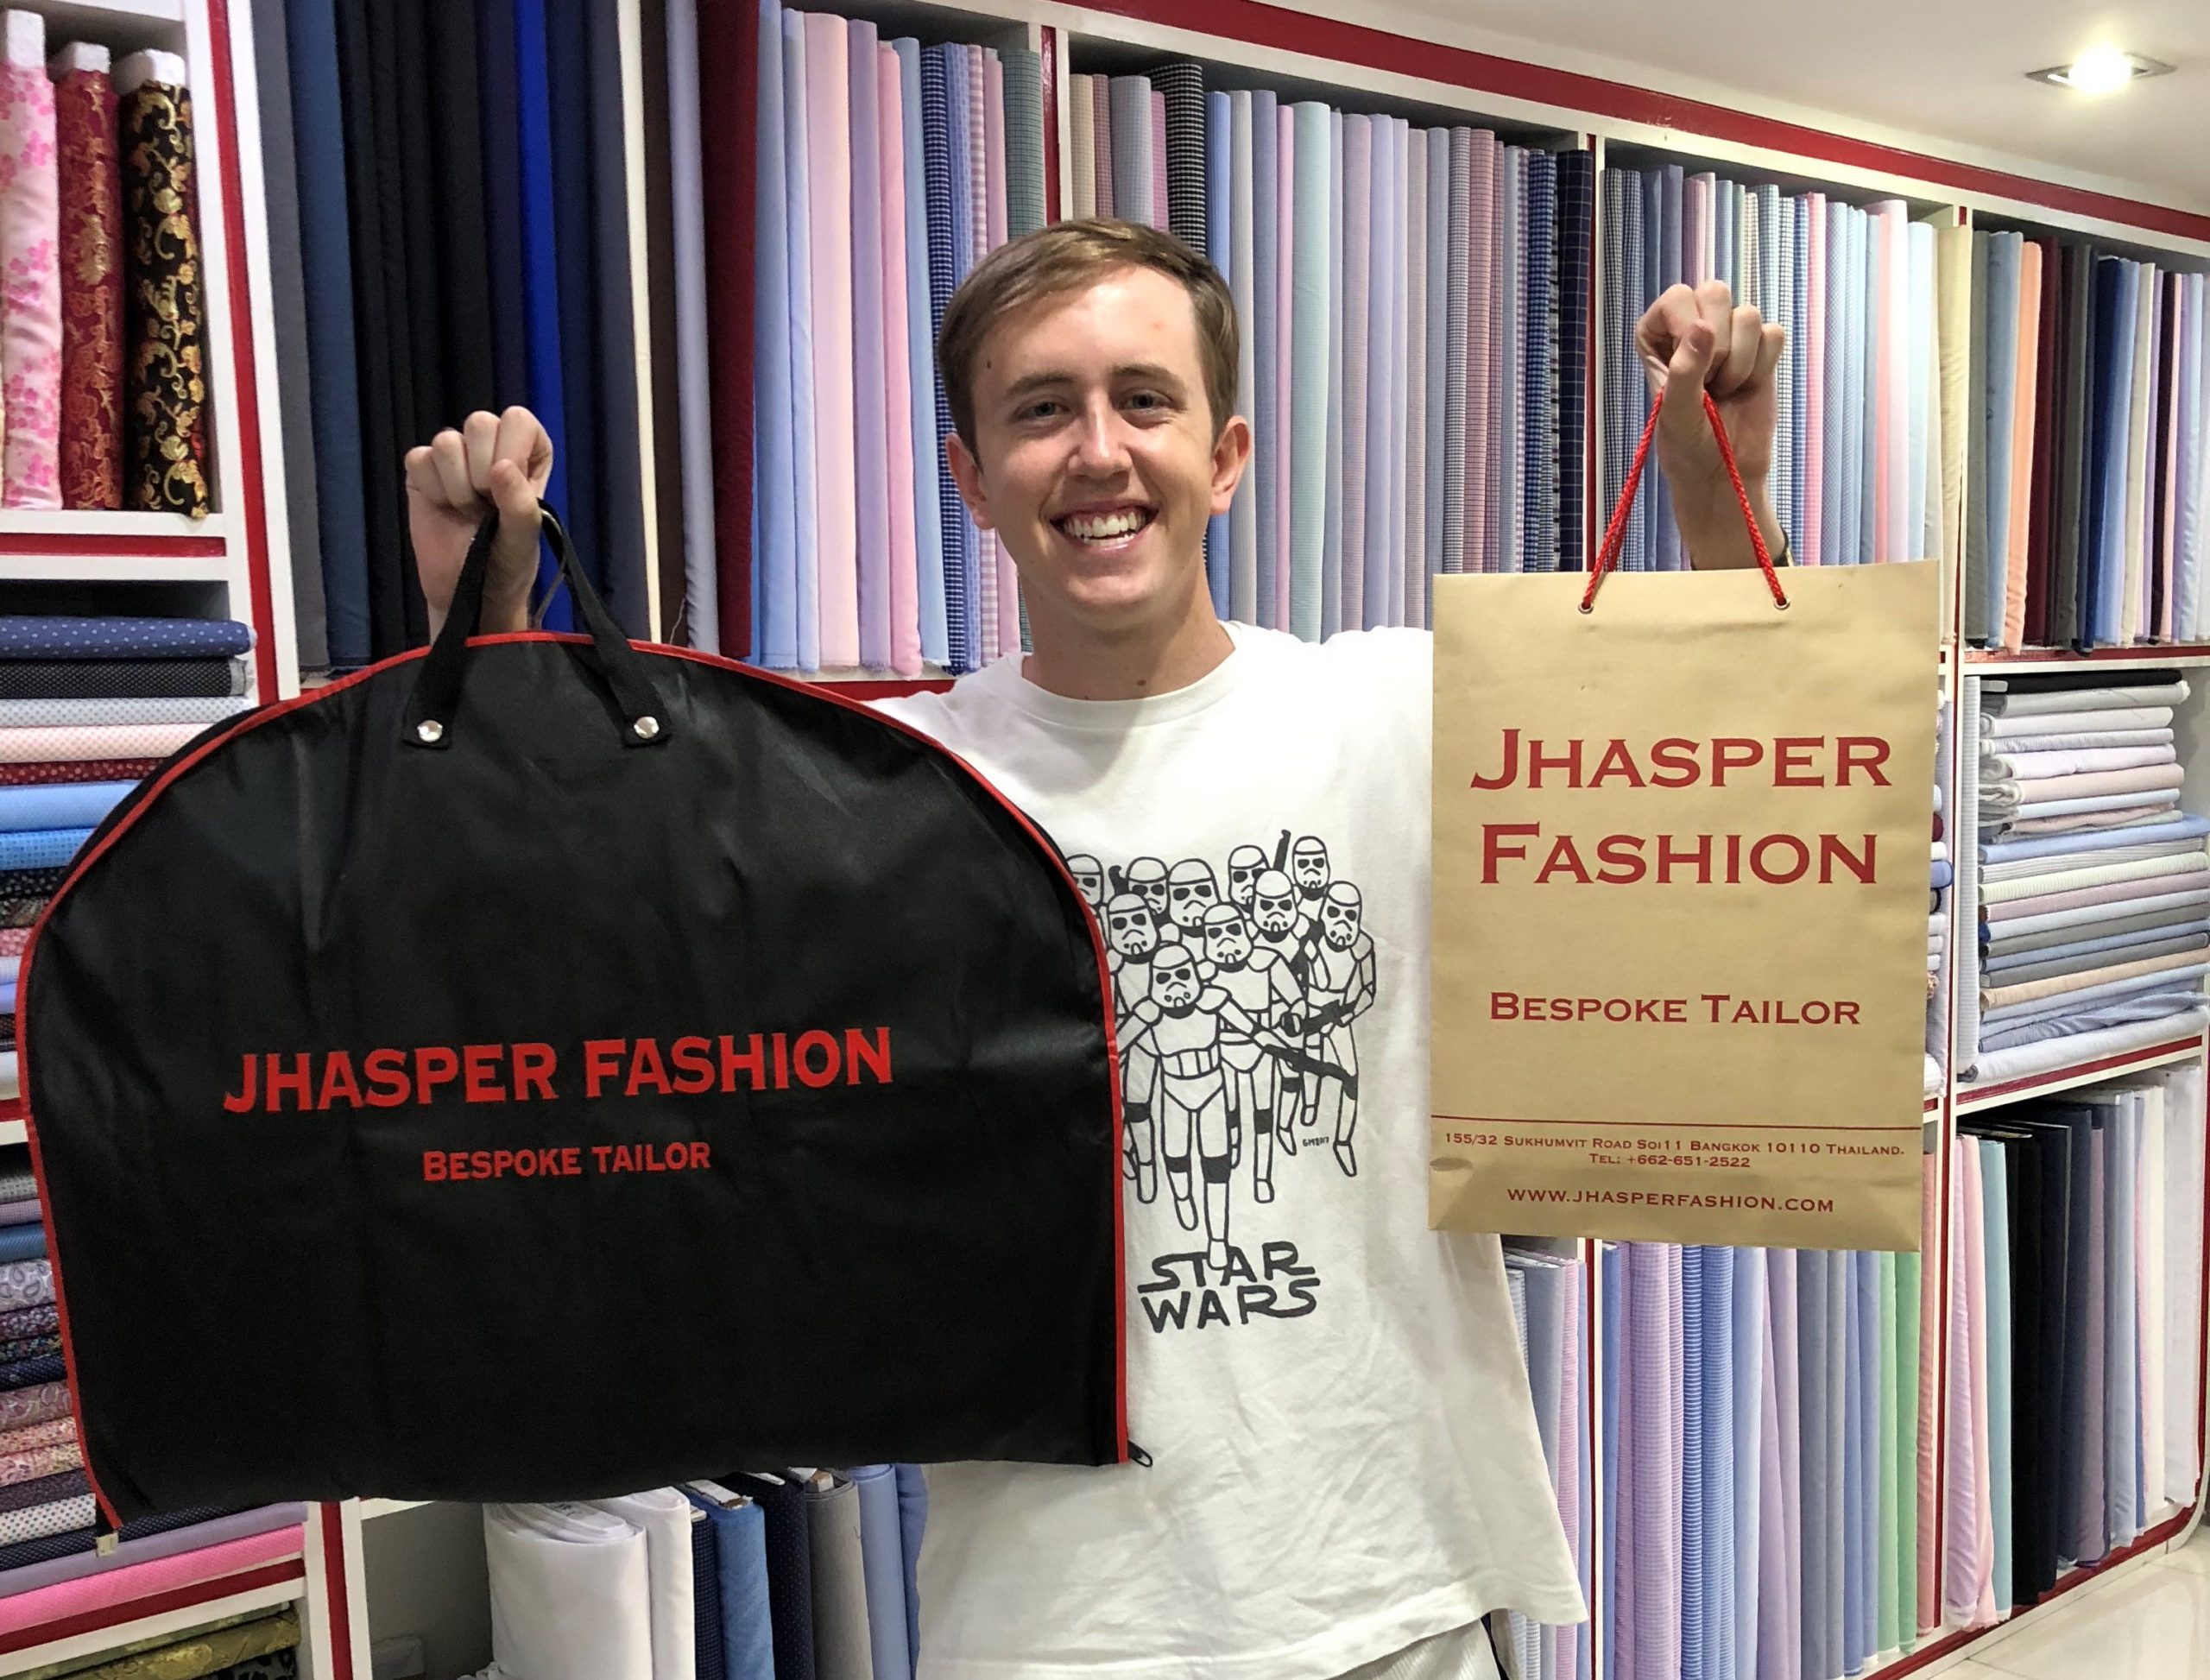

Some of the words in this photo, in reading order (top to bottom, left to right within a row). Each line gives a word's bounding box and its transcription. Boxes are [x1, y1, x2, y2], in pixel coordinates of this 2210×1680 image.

[1469, 728, 1892, 791] JHASPER
[1481, 821, 1878, 886] FASHION
[1489, 991, 1688, 1024] BESPOKE
[1701, 994, 1861, 1026] TAILOR
[223, 1042, 558, 1114] JHASPER
[584, 1026, 893, 1097] FASHION
[423, 1147, 582, 1182] BESPOKE
[591, 1142, 710, 1172] TAILOR
[1445, 1133, 1498, 1146] 155/32
[1504, 1135, 1588, 1148] SUKHUMVIT
[1592, 1138, 1632, 1150] ROAD
[1689, 1140, 1760, 1153] BANGKOK
[1767, 1142, 1821, 1154] 10110
[1826, 1144, 1904, 1155] THAILAND.
[1589, 1153, 1621, 1165] TEL:
[1626, 1154, 1751, 1168] +662-651-2522
[1507, 1189, 1834, 1213] WWW.JHASPERFASHION.COM
[1137, 1240, 1316, 1294] STAR
[1140, 1277, 1321, 1334] WARS
